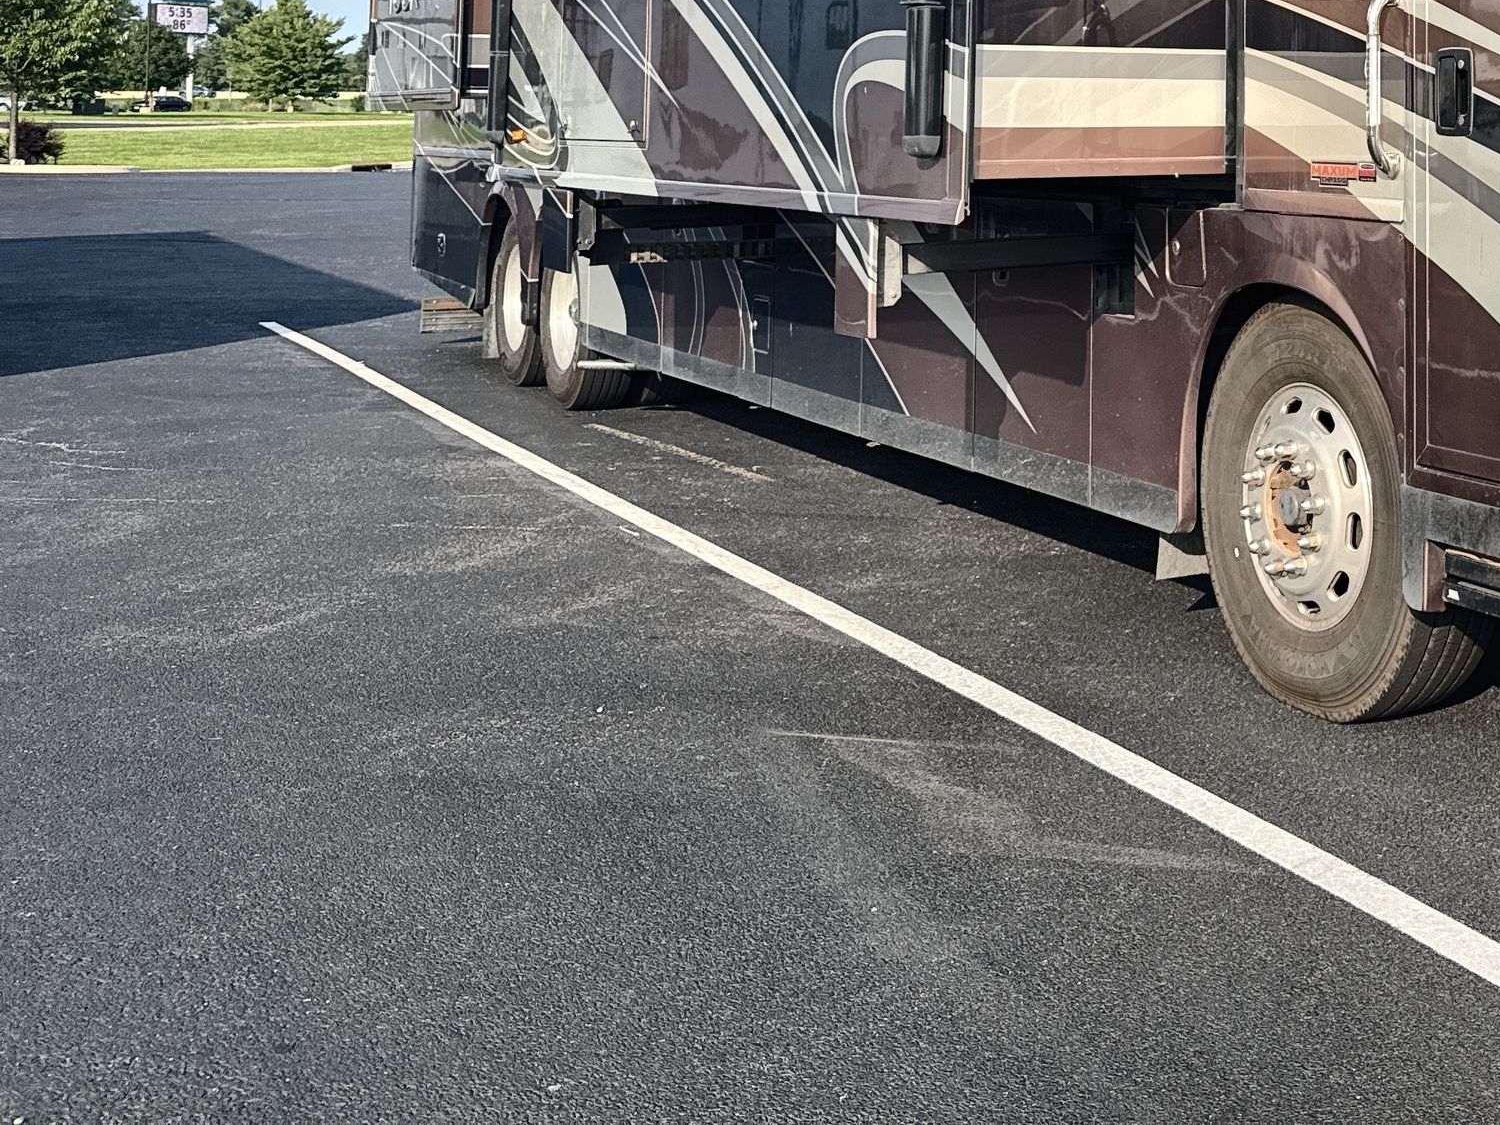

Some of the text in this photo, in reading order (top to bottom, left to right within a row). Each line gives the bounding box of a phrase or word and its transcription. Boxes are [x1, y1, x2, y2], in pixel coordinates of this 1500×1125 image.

[169, 7, 192, 18] 5:35
[1311, 165, 1356, 176] MAXUM
[1321, 176, 1348, 184] CHASSIS
